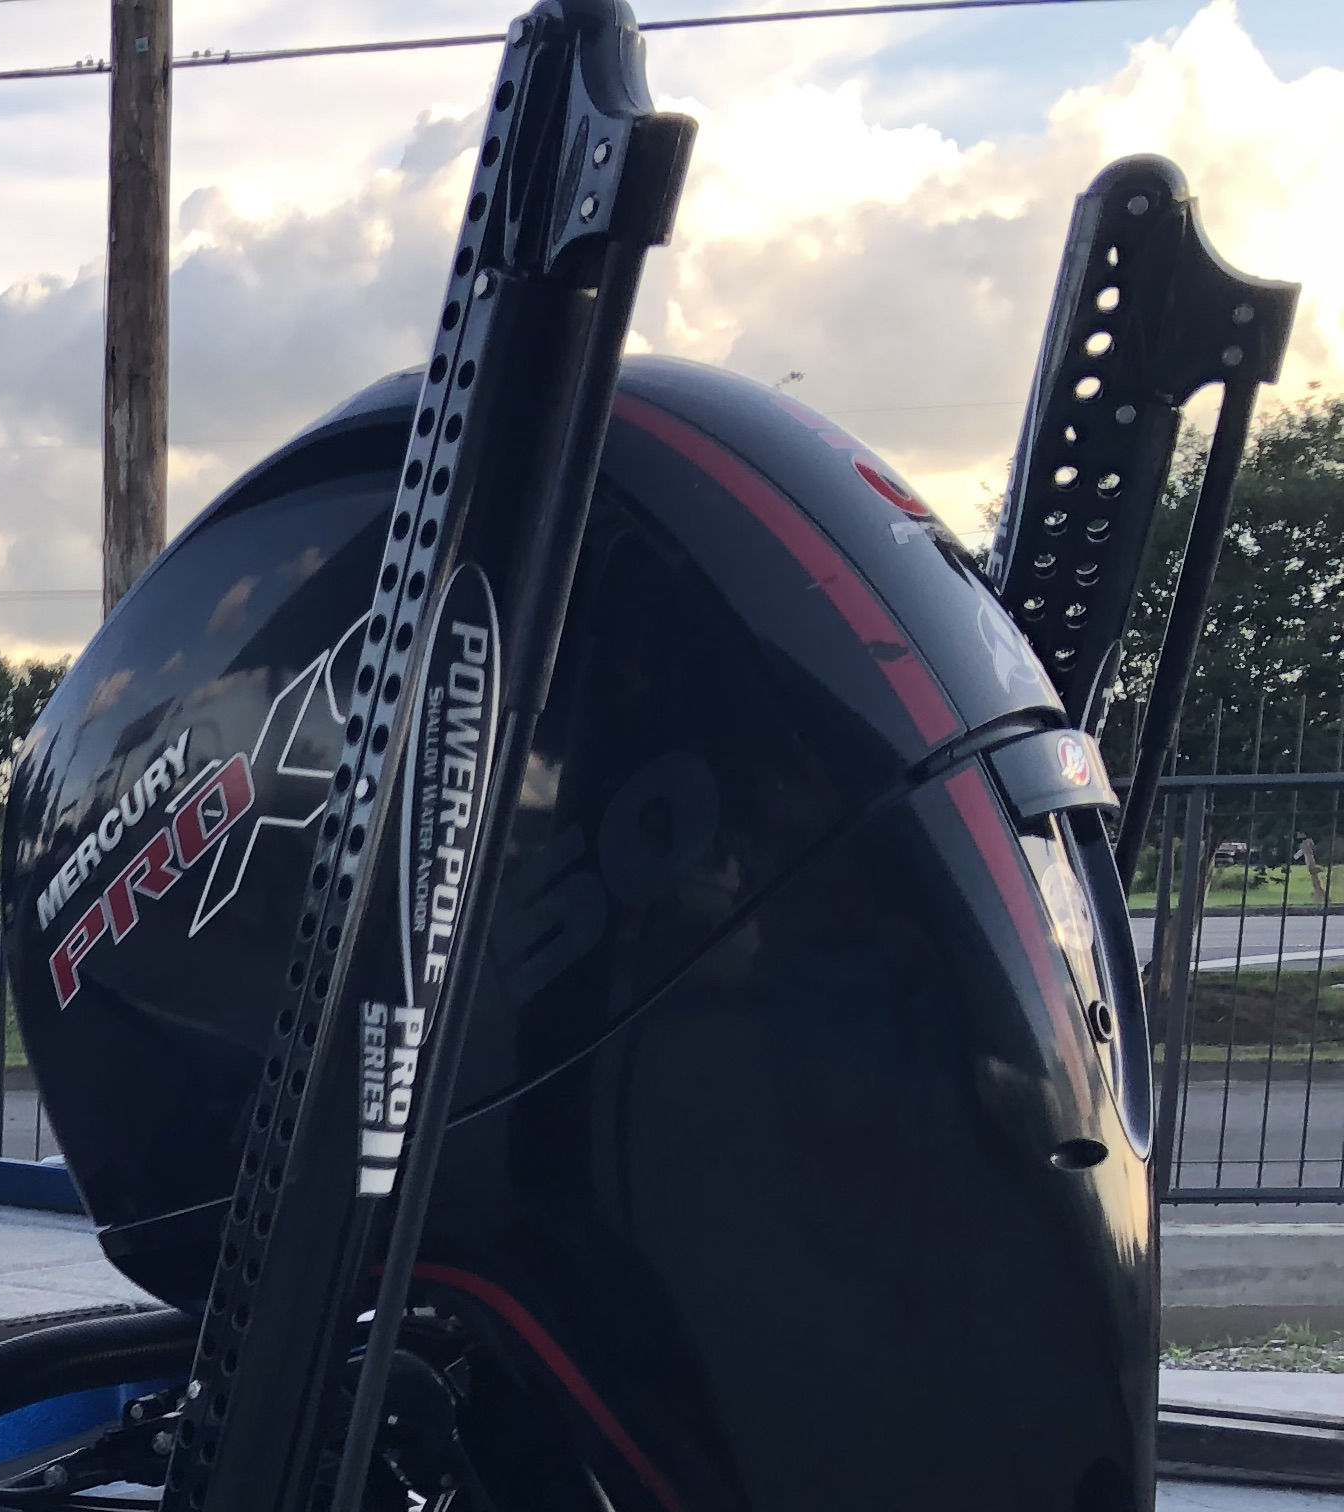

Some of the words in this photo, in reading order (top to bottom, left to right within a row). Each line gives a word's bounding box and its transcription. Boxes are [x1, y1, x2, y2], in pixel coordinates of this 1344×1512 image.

[422, 685, 445, 779] SHALLOW
[36, 727, 190, 932] MERCURY
[418, 784, 439, 851] WATER
[423, 619, 489, 986] POWER-POLE
[48, 751, 256, 1012] PRO
[413, 856, 434, 933] ANCHOR
[362, 1000, 389, 1123] SERIES
[387, 1006, 426, 1127] PRO
